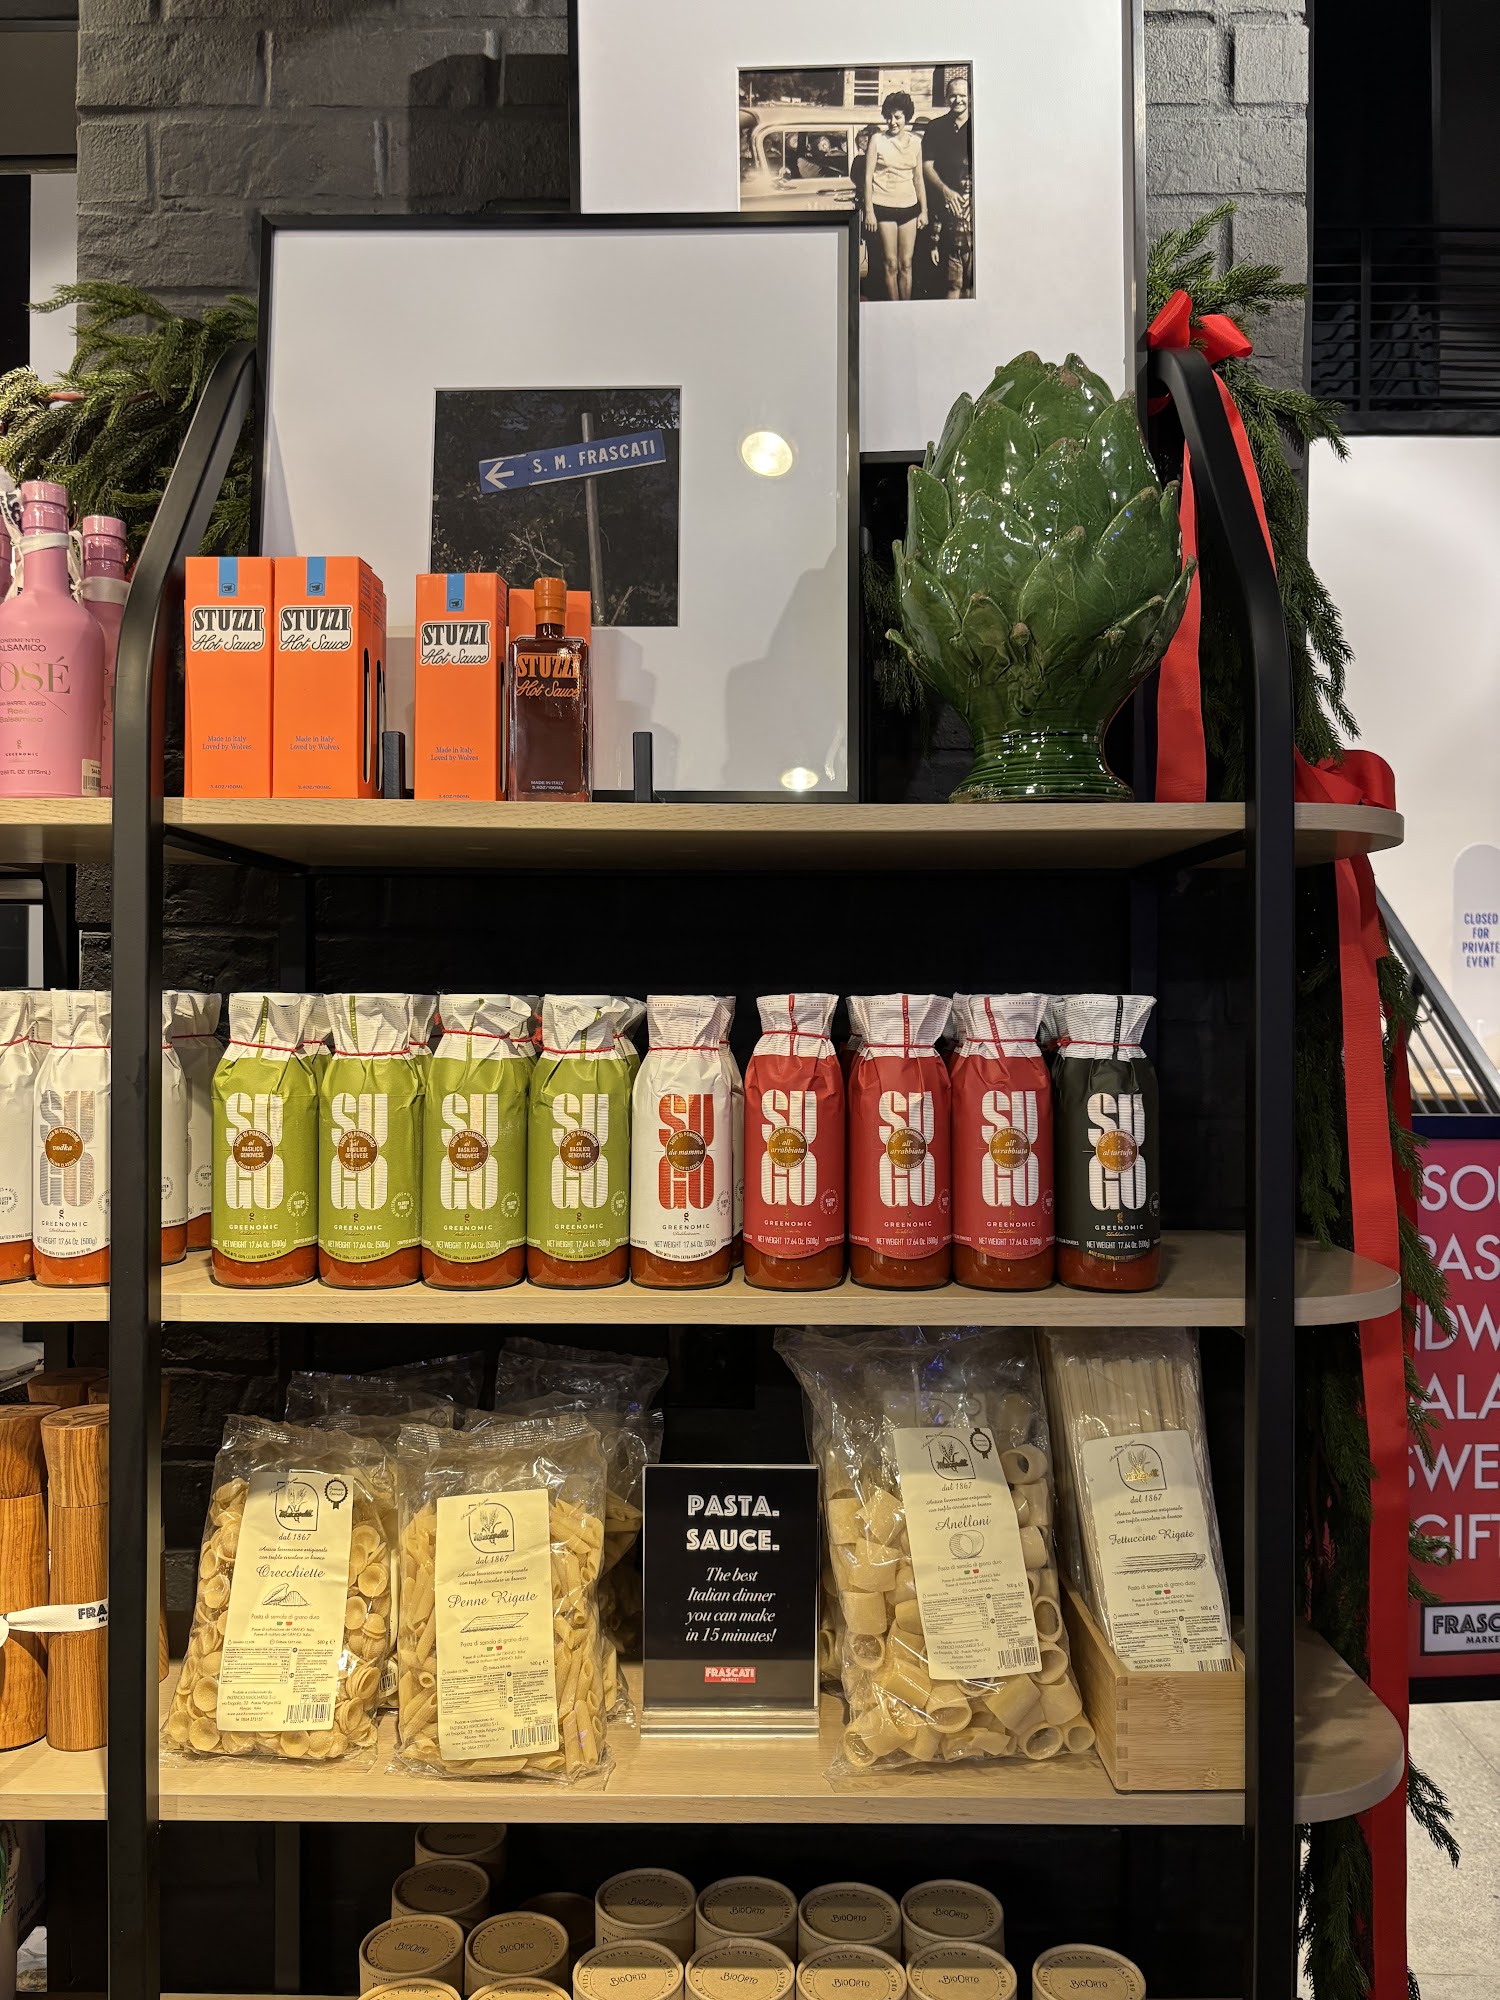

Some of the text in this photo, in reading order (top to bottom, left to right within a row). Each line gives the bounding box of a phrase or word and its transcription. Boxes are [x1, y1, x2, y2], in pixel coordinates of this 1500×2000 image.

[533, 440, 656, 474] S. M. FRASCATI
[192, 608, 263, 631] STUZZI
[281, 608, 350, 631] STUZZI
[192, 634, 263, 650] Hot Sauce
[280, 634, 350, 650] Hot Sauce
[422, 623, 488, 646] STUZZI
[421, 648, 489, 665] Hot Sauce
[516, 654, 581, 678] STUZZI
[516, 680, 579, 698] Hot Sauce
[232, 735, 246, 743] Italy
[1464, 912, 1498, 925] CLOSED
[1472, 927, 1489, 939] FOR
[1462, 942, 1500, 954] PRIVATE
[1466, 956, 1495, 968] EVENT
[40, 1090, 95, 1144] SU
[226, 1092, 284, 1148] SU
[332, 1092, 388, 1148] SU
[441, 1093, 498, 1148] SU
[552, 1093, 609, 1148] SU
[658, 1094, 714, 1148] SU
[762, 1090, 818, 1144] SU
[878, 1090, 934, 1145] SU
[982, 1090, 1038, 1145] SU
[1087, 1093, 1146, 1148] SU
[52, 1144, 72, 1152] vodka
[1111, 1148, 1133, 1157] tartufo
[40, 1152, 95, 1206] GO
[226, 1154, 284, 1210] GO
[331, 1154, 388, 1210] GO
[440, 1154, 498, 1210] GO
[552, 1154, 608, 1210] GO
[658, 1154, 714, 1210] GO
[761, 1151, 817, 1206] GO
[880, 1151, 936, 1207] GO
[982, 1152, 1039, 1206] GO
[1088, 1154, 1146, 1210] GO
[1420, 1164, 1500, 1212] SO
[662, 1240, 682, 1249] WEIGHT
[1414, 1303, 1500, 1352] DW
[942, 1482, 972, 1492] dal 1867
[688, 1494, 780, 1517] PASTA.
[1130, 1494, 1162, 1504] dal 1867
[686, 1528, 780, 1551] SAUCE.
[1108, 1528, 1195, 1545] Fettuccine Rigate
[476, 1554, 510, 1564] dal 1867
[256, 1564, 326, 1578] Orecchiette
[706, 1566, 758, 1582] The best
[448, 1590, 538, 1608] Penne Rigate
[687, 1587, 776, 1602] Italian dinner
[686, 1608, 776, 1626] you can make
[686, 1628, 777, 1642] in 15 minutes!
[705, 1668, 755, 1678] FRASCATI
